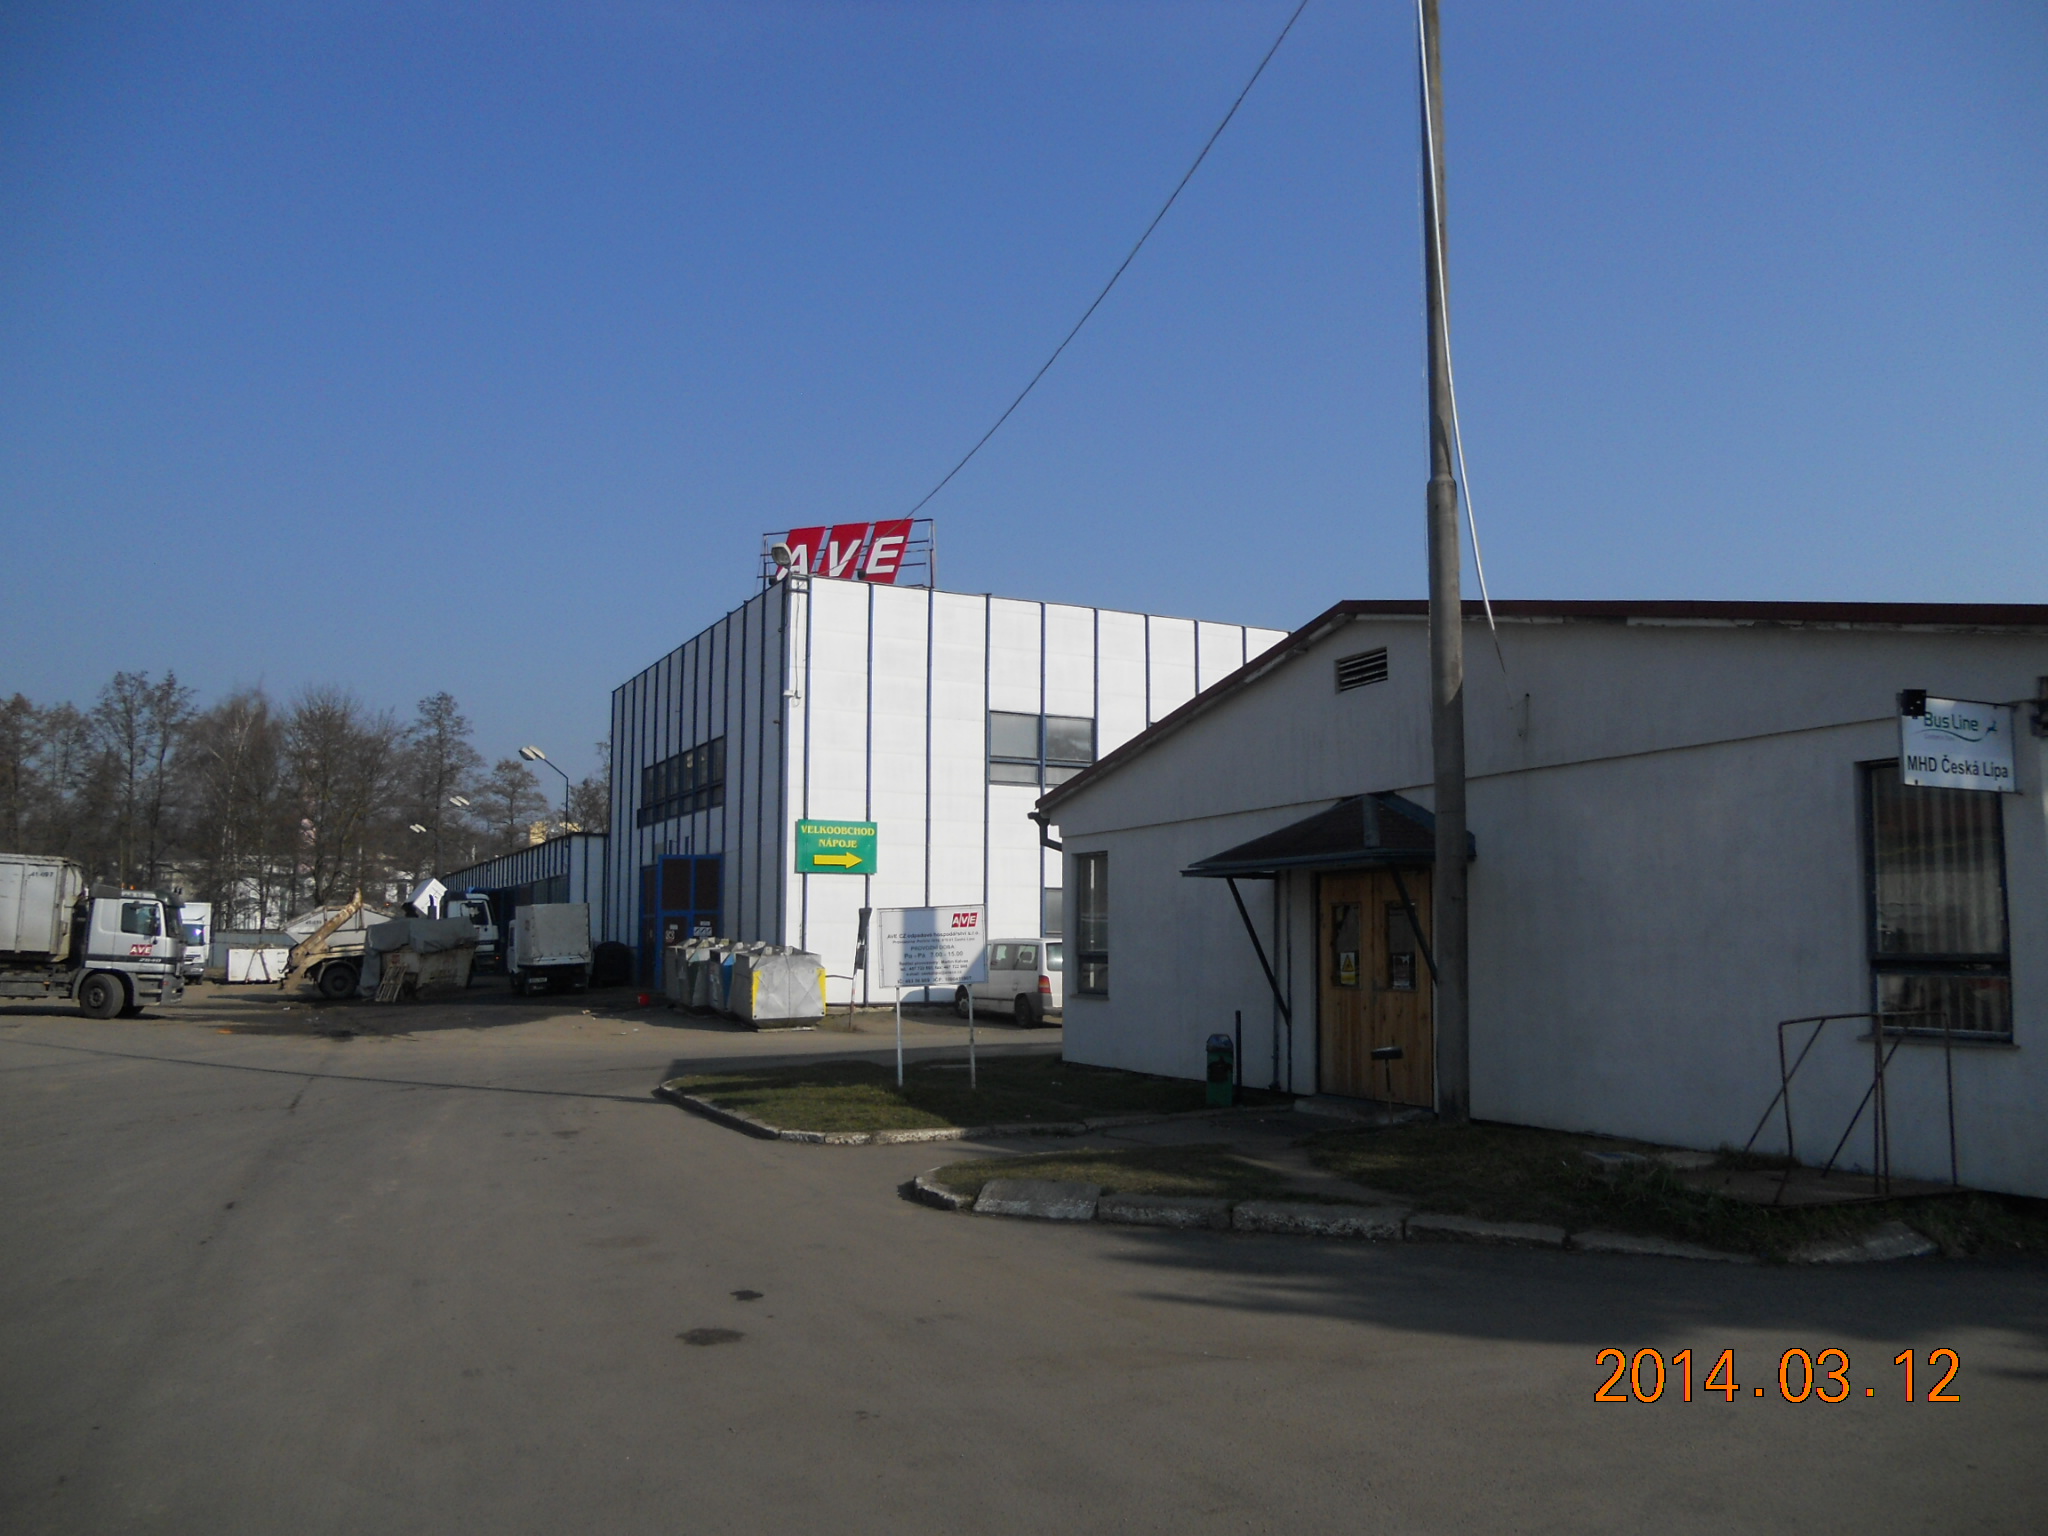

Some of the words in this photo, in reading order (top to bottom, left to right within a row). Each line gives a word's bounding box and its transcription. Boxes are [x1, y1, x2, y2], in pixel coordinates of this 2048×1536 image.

[776, 536, 905, 581] AVE
[1907, 755, 1938, 772] MHD
[1941, 755, 1979, 776] Česká
[801, 824, 875, 836] VELKOOBCHOD
[818, 837, 858, 848] NÁPOJE
[952, 915, 976, 926] AVE
